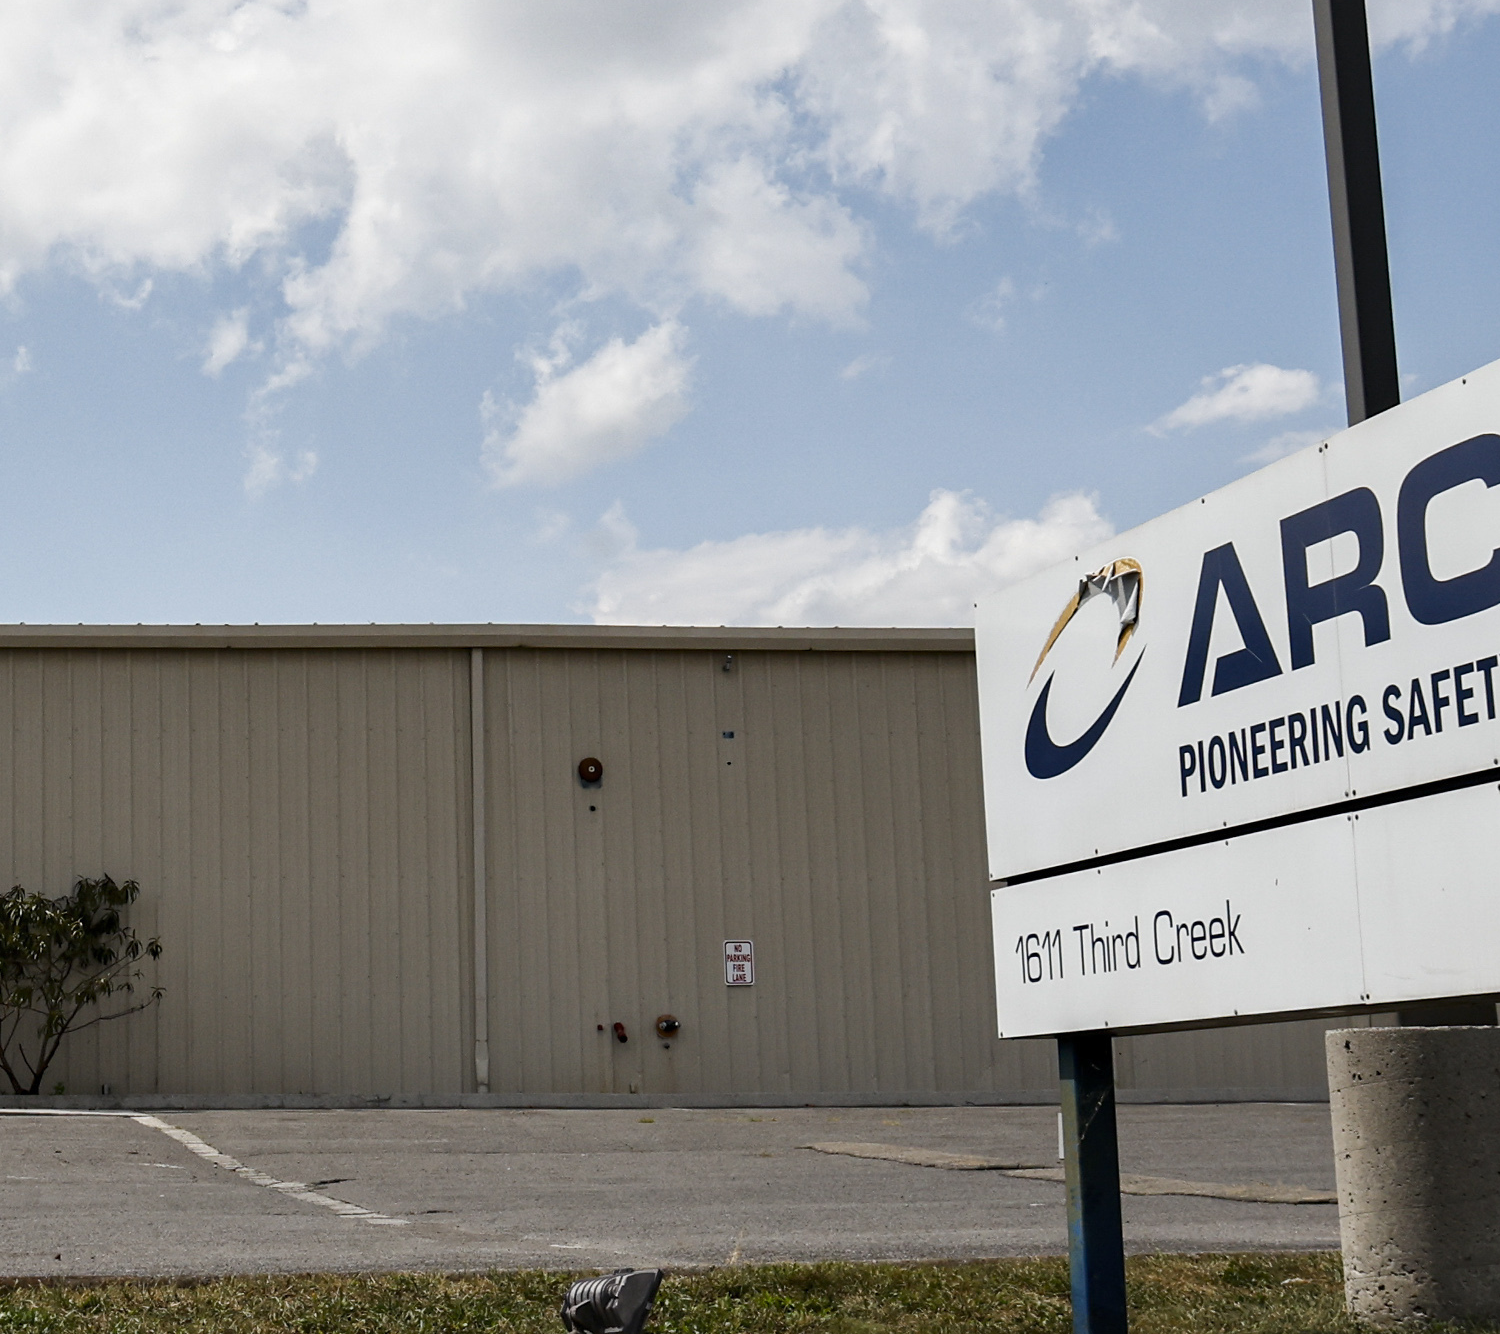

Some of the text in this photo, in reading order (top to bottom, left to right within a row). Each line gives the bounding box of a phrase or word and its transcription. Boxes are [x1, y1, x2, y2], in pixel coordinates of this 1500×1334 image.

[1178, 694, 1371, 798] PIONEERING
[1015, 899, 1245, 985] 1611 Third Creek
[734, 944, 742, 952] NO
[726, 954, 751, 962] PARKING
[733, 964, 745, 972] FIRE
[733, 973, 746, 981] LANE
